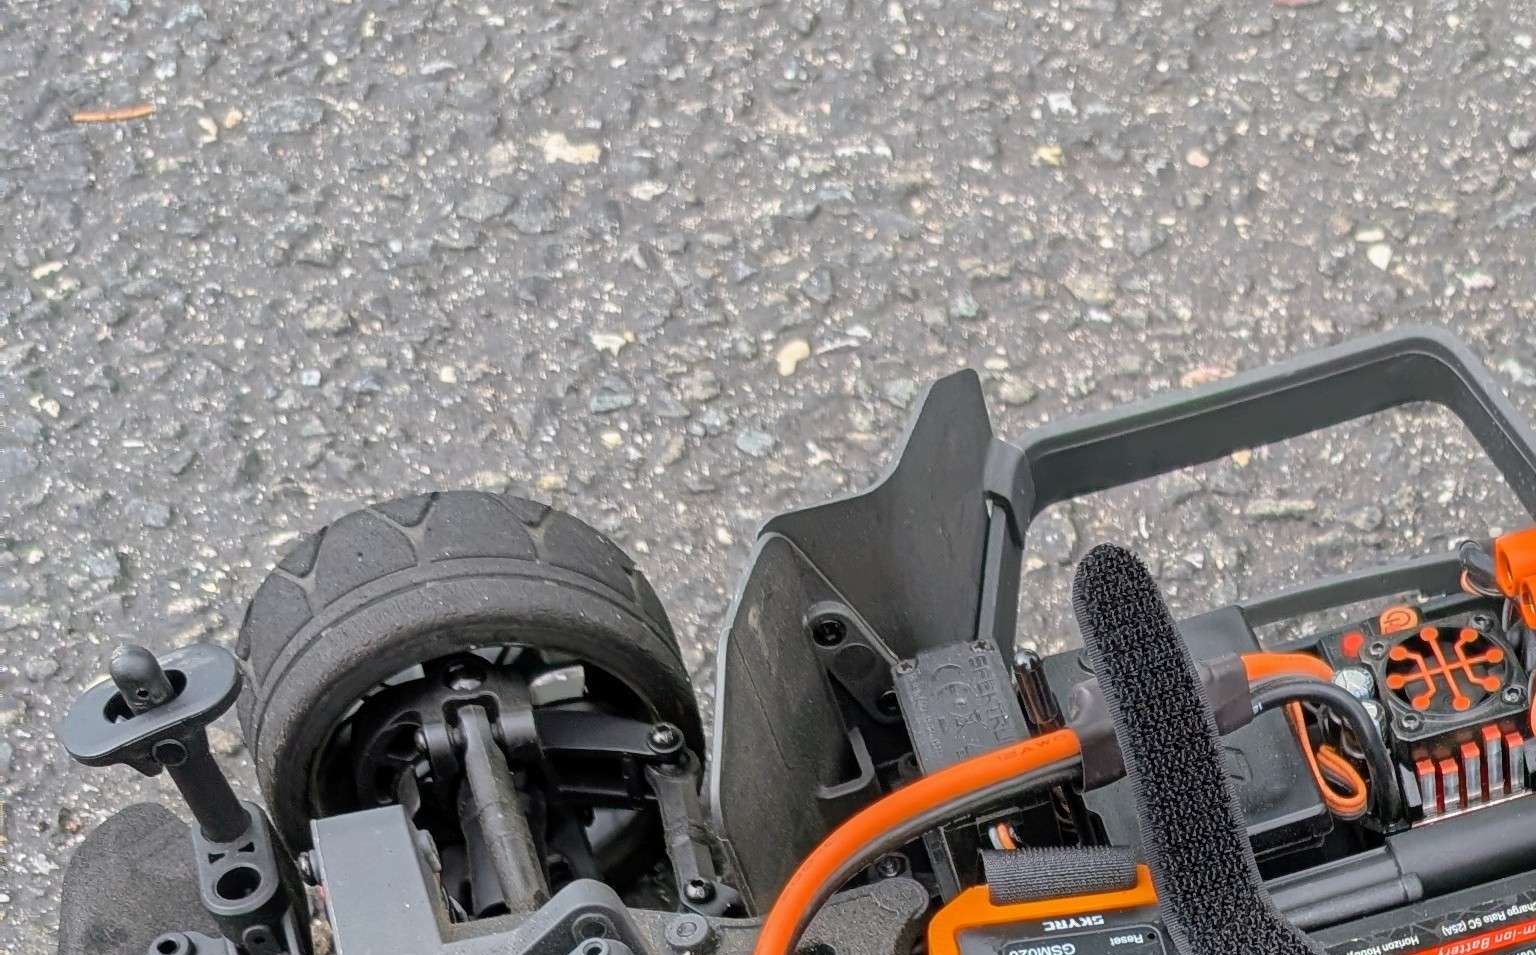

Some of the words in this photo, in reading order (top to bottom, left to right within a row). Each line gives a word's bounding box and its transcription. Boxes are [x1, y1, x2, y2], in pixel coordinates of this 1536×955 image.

[1042, 915, 1105, 931] SKYRC
[1482, 911, 1506, 927] Rate
[1442, 920, 1467, 937] (25A)
[1110, 933, 1144, 946] Reset
[1380, 935, 1420, 955] Horizon
